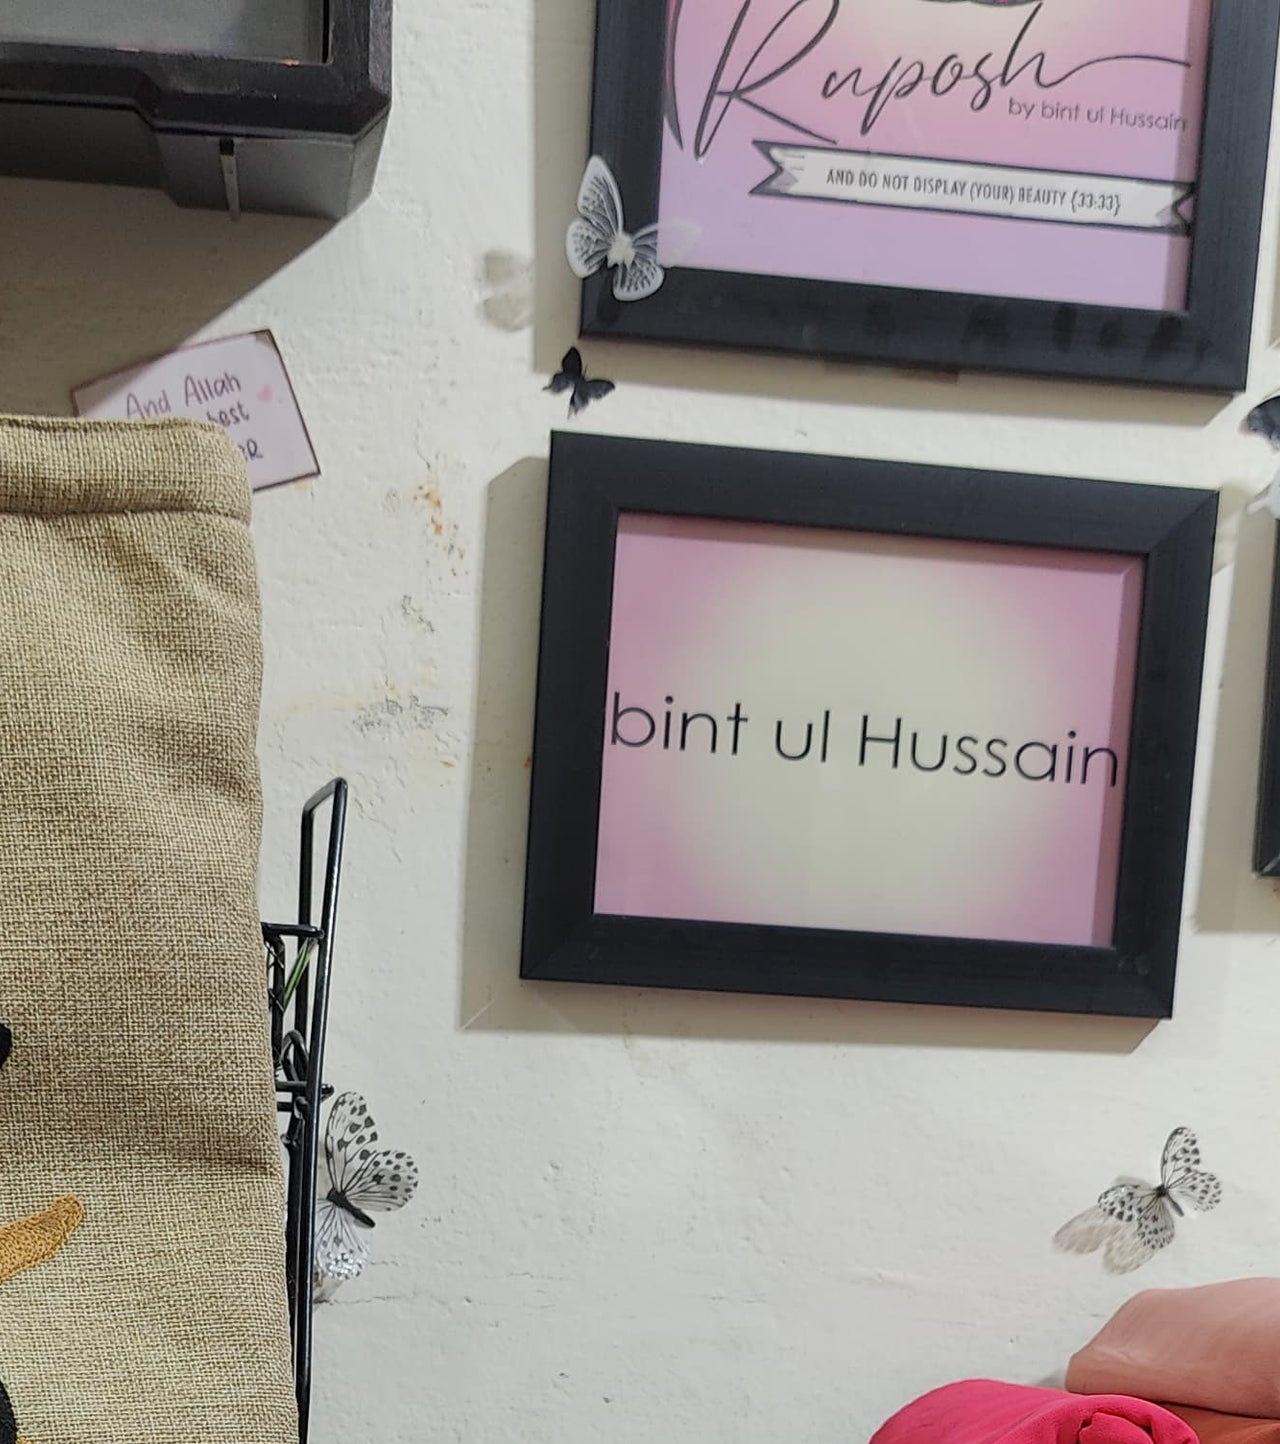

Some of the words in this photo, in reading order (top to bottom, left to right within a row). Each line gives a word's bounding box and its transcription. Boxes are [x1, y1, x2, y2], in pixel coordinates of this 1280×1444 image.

[1008, 97, 1035, 120] by
[1041, 100, 1080, 122] bint
[1086, 105, 1105, 124] ul
[1110, 107, 1186, 132] Hussain
[826, 168, 854, 186] AND
[858, 170, 878, 189] DO
[882, 173, 909, 191] NOT
[913, 176, 967, 197] DISPLAY
[970, 181, 1014, 205] (YOUR)
[1018, 186, 1066, 206] BEAUTY
[125, 390, 171, 419] And
[183, 371, 242, 407] Allah
[609, 690, 749, 757] bint
[774, 709, 831, 764] ul
[857, 713, 1120, 788] Hussain
